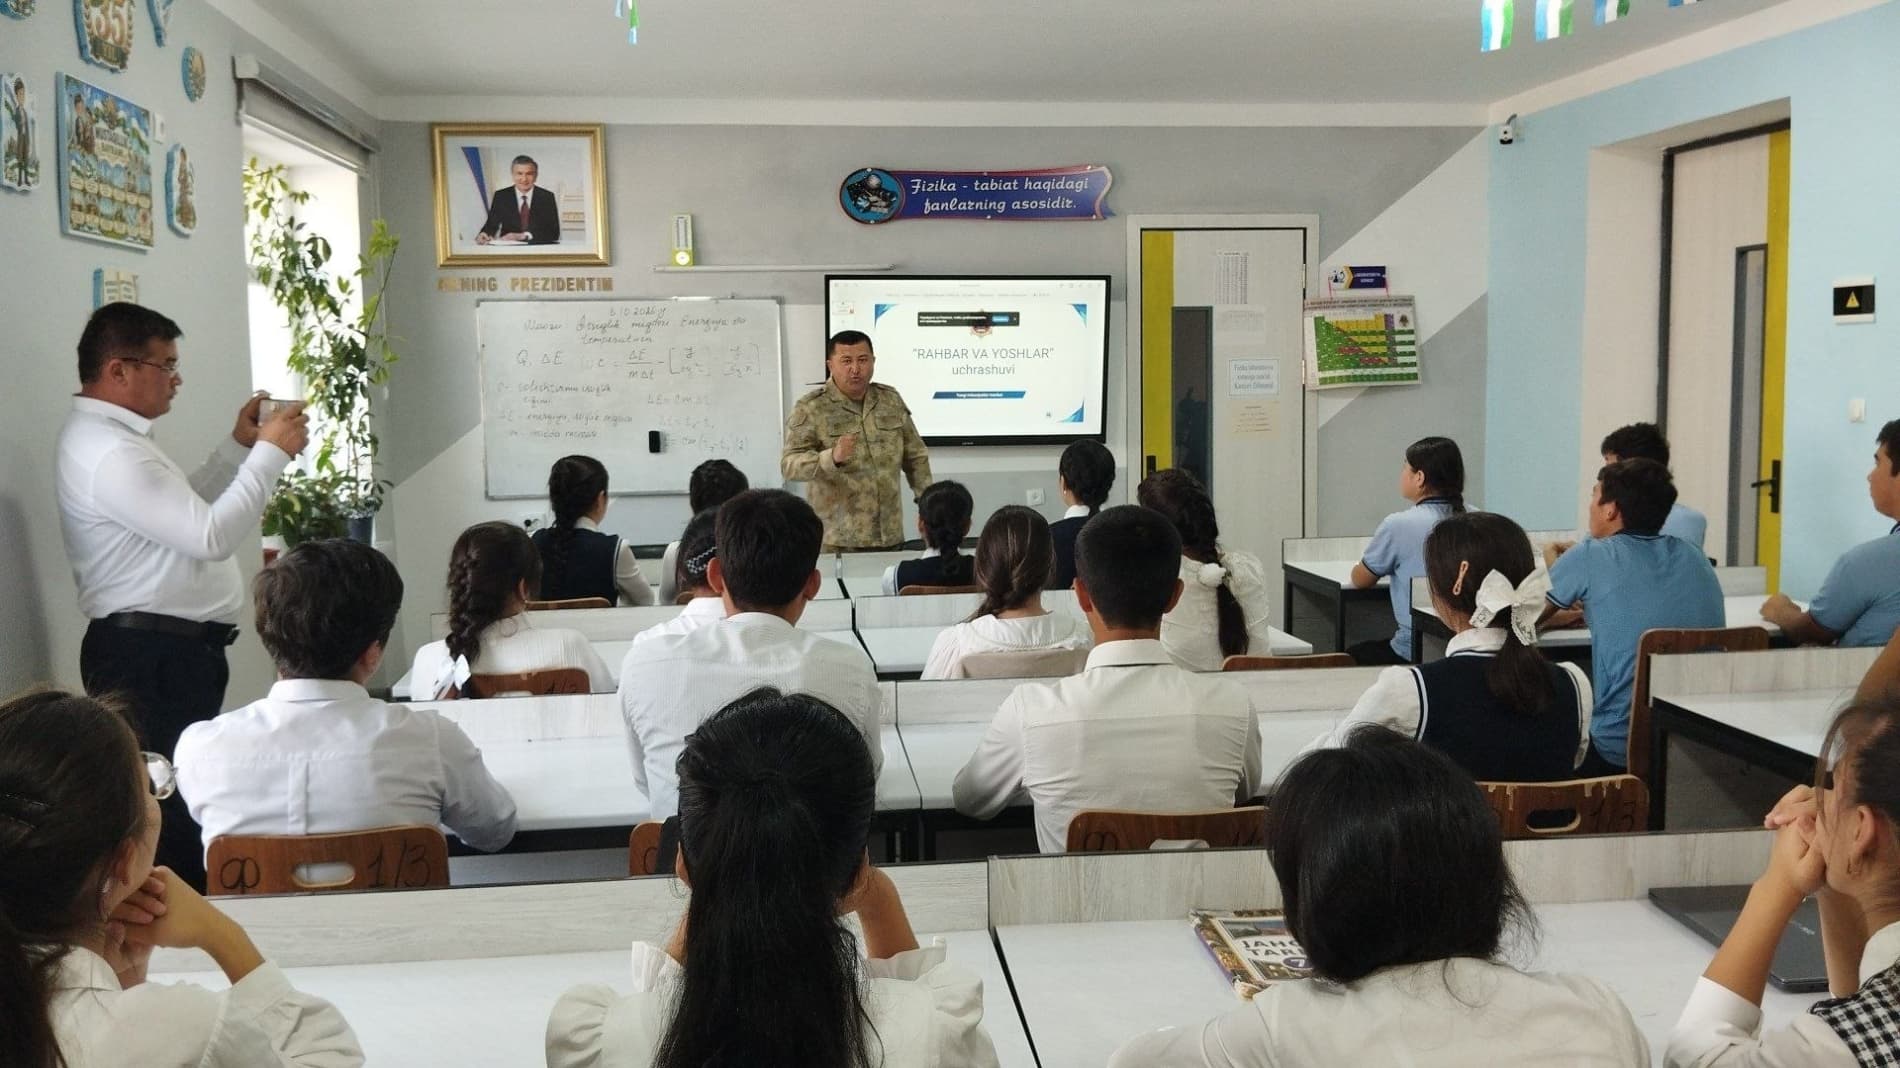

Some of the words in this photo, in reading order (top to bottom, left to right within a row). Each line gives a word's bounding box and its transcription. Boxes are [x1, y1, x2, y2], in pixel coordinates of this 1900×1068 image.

[910, 178, 957, 195] Fizika
[973, 179, 1019, 192] tabiat
[1024, 177, 1089, 194] haqidagi
[923, 199, 1006, 214] fanlarning
[1011, 198, 1077, 210] asosidir.
[511, 277, 613, 292] PREZIDENTIM
[971, 348, 989, 360] VA
[952, 363, 1015, 376] uchrashuvi
[1290, 958, 1306, 968] 7
